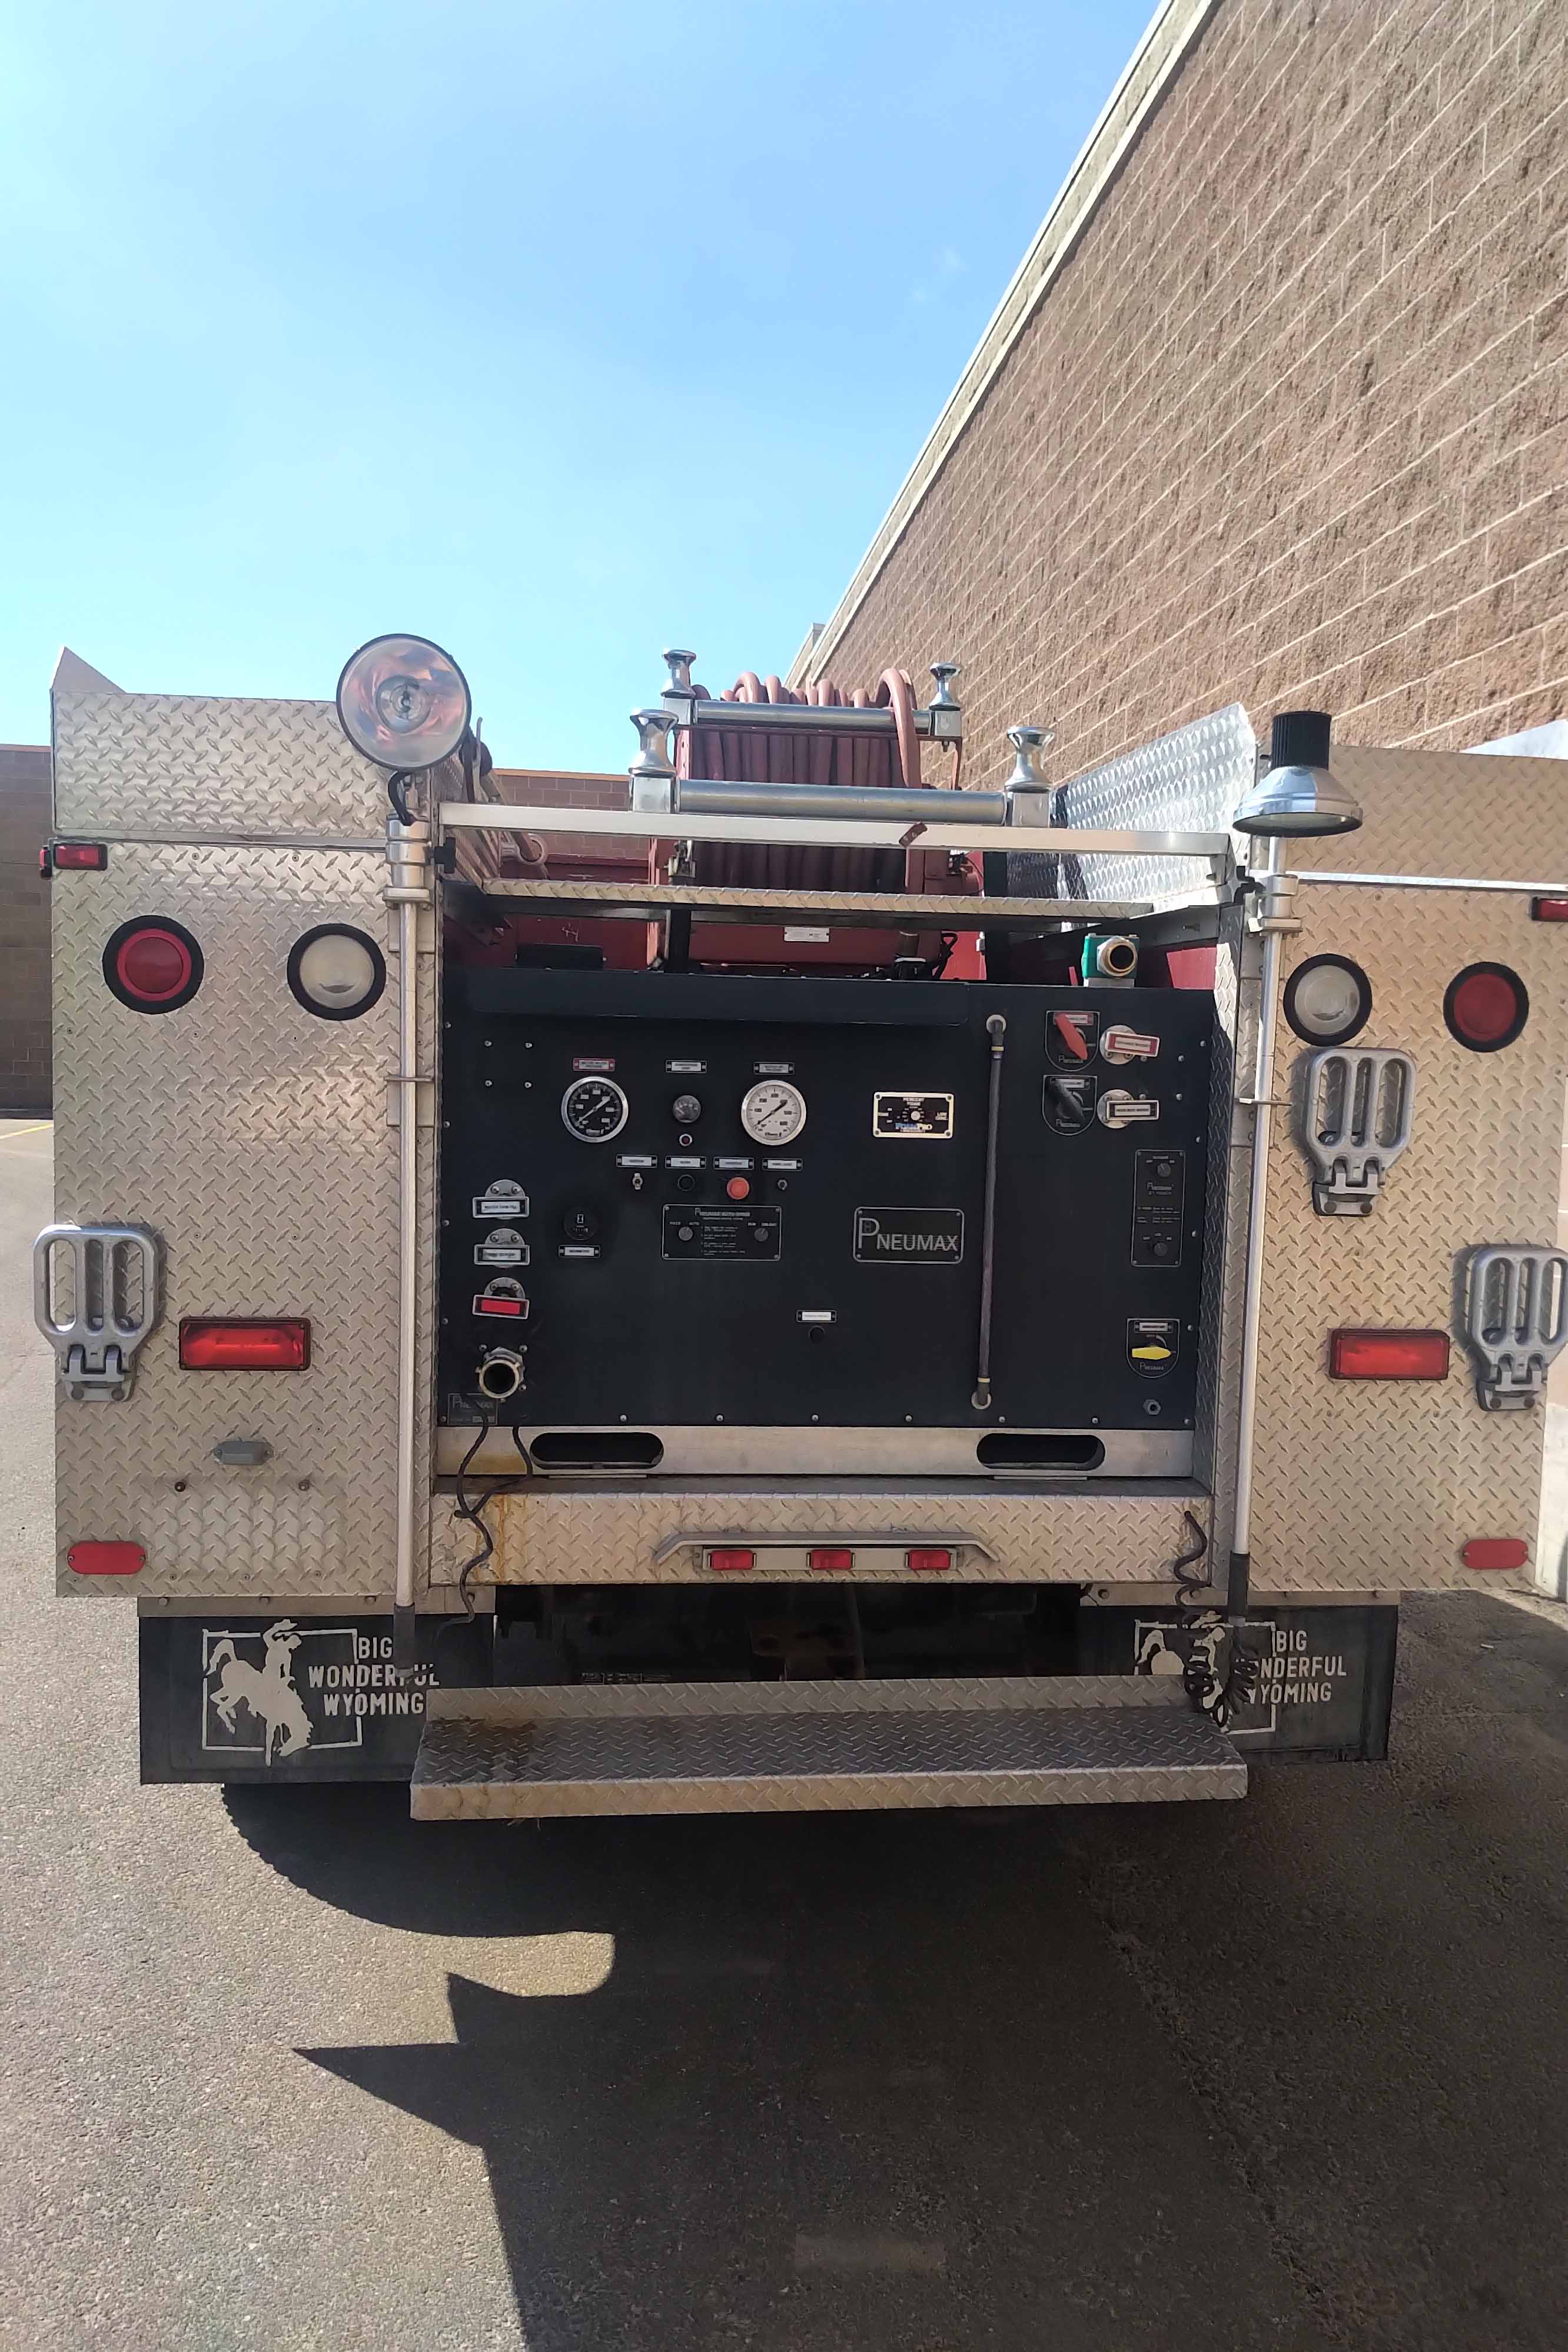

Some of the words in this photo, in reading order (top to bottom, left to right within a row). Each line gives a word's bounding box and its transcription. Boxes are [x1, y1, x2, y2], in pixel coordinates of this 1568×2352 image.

[858, 1218, 958, 1251] PNEUMAX
[358, 1637, 393, 1659] BIG
[1276, 1630, 1307, 1652] BIG
[324, 1693, 424, 1716] WYOMING
